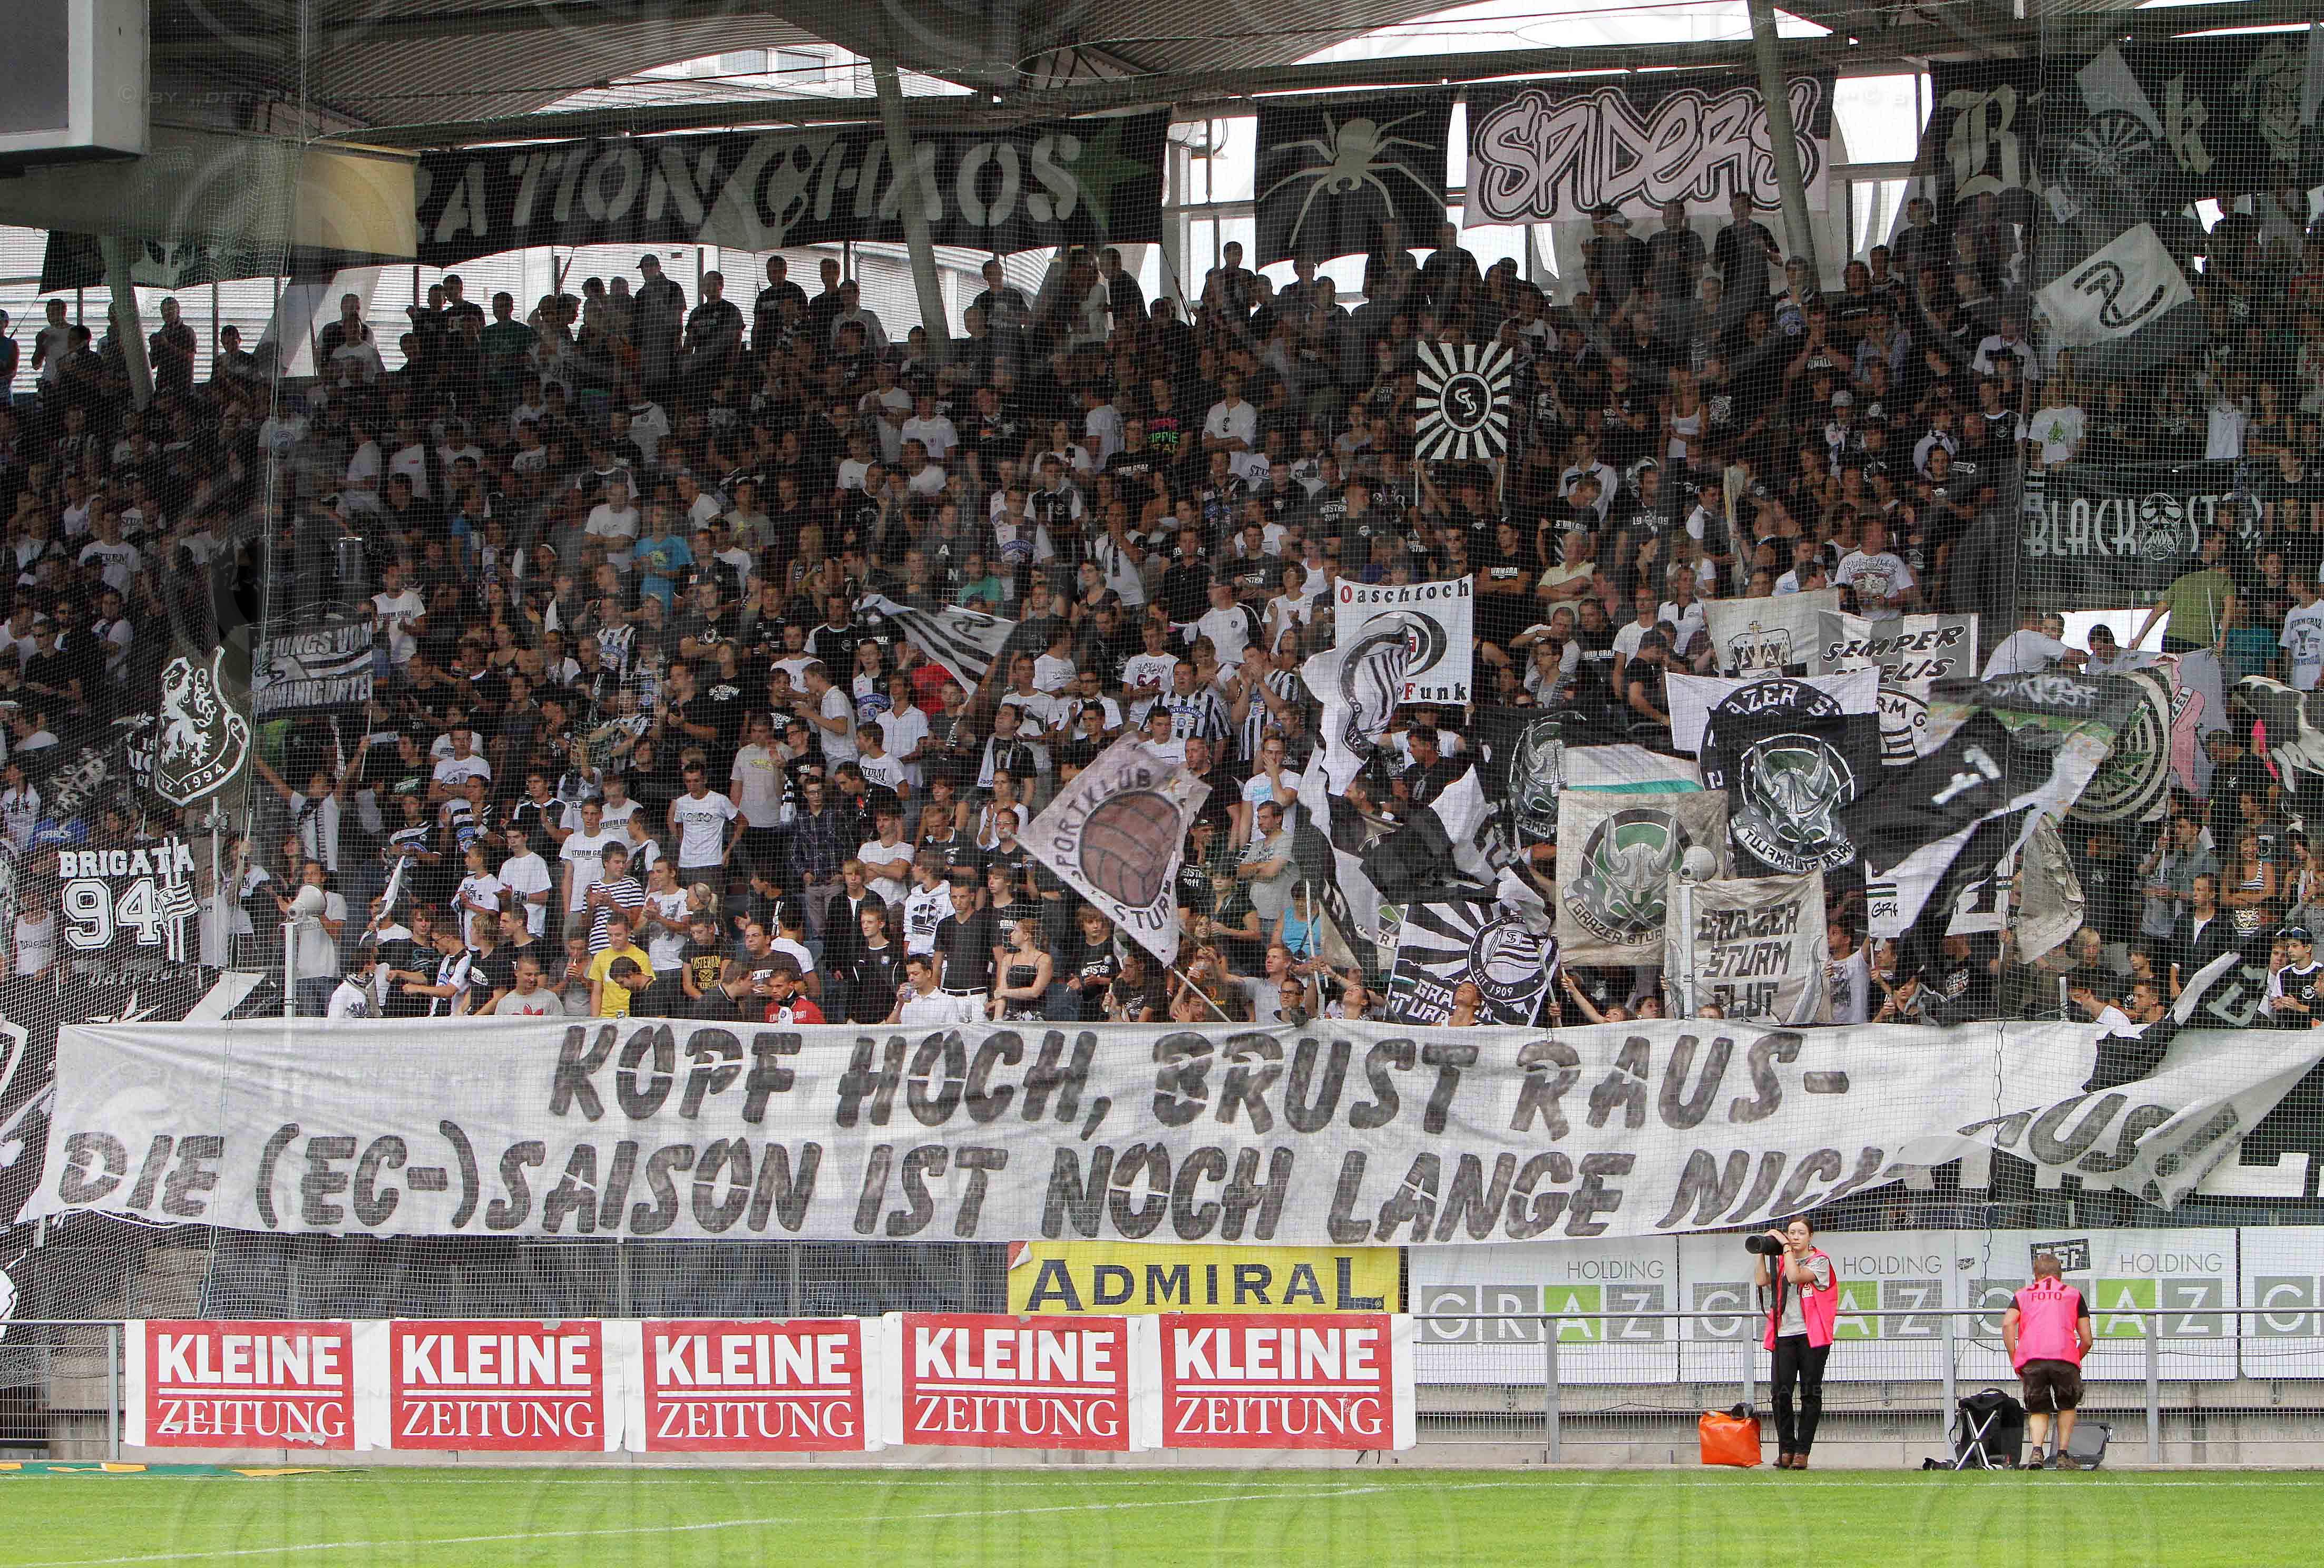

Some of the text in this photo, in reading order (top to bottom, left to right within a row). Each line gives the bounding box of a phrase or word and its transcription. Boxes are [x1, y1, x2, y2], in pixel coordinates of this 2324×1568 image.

[274, 631, 332, 658] JUNGS
[337, 622, 373, 653] VOM
[1821, 625, 1965, 662] SEMPER
[1404, 683, 1467, 700] Funk
[183, 762, 227, 793] 1994
[861, 765, 886, 782] STURM
[59, 844, 196, 877] BRIGATA
[62, 877, 167, 950] 94
[1571, 903, 1623, 944] GRAZER
[1081, 965, 1109, 977] MEISTER
[1703, 941, 1792, 978] STURM
[1489, 984, 1514, 997] 1909
[549, 1024, 1850, 1142] KOPF HOCH, BRUST RAUS-
[58, 1131, 225, 1218] DIE
[854, 1144, 1009, 1237] IST
[1041, 1141, 1294, 1241] NOCH
[1327, 1150, 1636, 1244] LANGE
[1567, 1259, 1665, 1280] HOLDING
[1843, 1255, 1942, 1275] HOLDING
[2121, 1253, 2222, 1273] HOLDING
[1024, 1257, 1384, 1311] ADMIRAL
[2031, 1291, 2063, 1302] FOTO
[1428, 1292, 1653, 1340] GRAZ
[1701, 1289, 1930, 1338] GAZ
[157, 1334, 343, 1385] KLEINE
[402, 1334, 592, 1385] KLEINE
[655, 1334, 851, 1385] KLEINE
[915, 1327, 1116, 1383] KLEINE
[1174, 1328, 1380, 1381] KLEINE
[157, 1398, 346, 1438] ZEITUNG
[402, 1400, 594, 1438] ZEITUNG
[657, 1400, 855, 1439] ZEITUNG
[914, 1394, 1119, 1436] ZEITUNG
[1175, 1396, 1383, 1436] ZEITUNG
